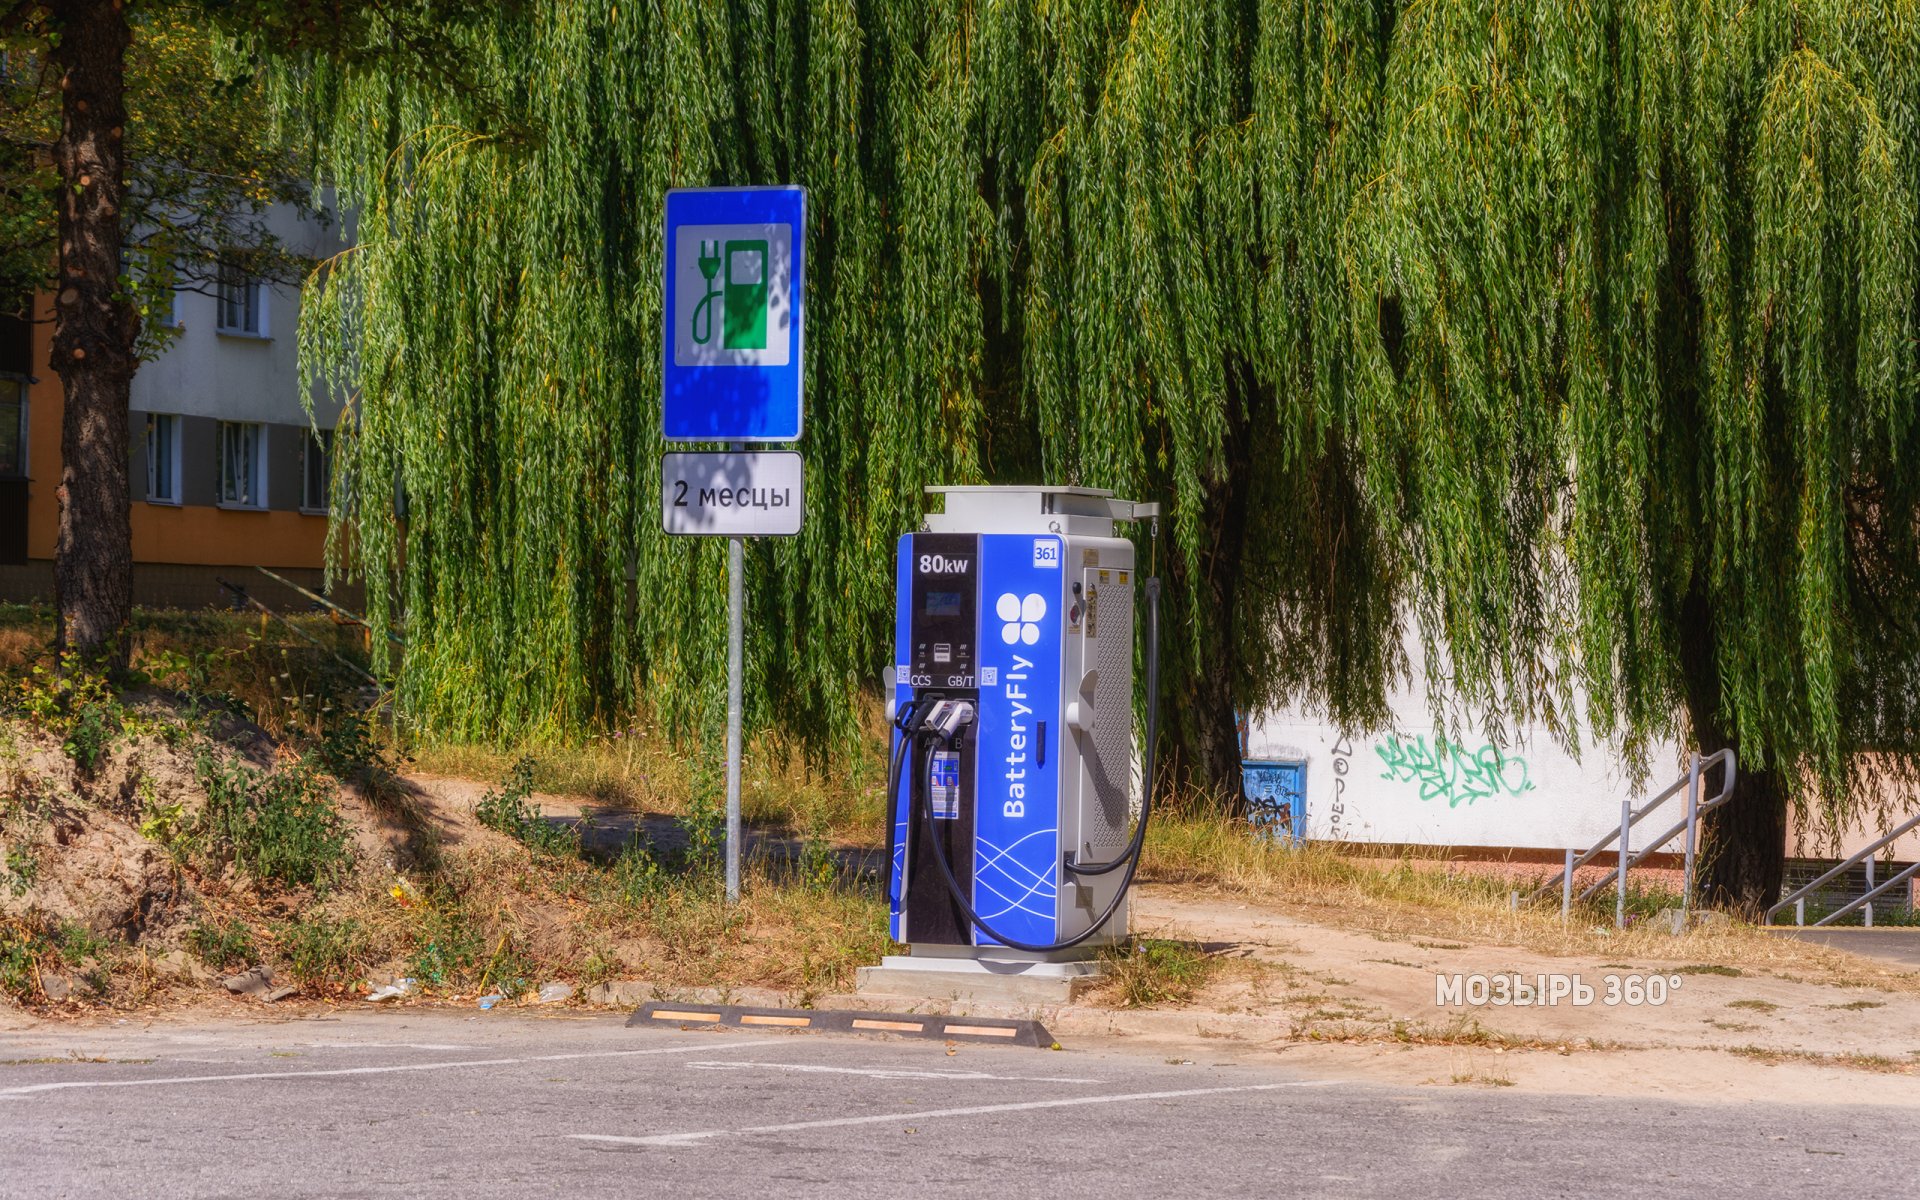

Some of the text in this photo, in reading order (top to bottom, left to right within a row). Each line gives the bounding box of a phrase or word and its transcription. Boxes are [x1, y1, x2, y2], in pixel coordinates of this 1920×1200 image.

[674, 480, 790, 511] 2 месцы
[1035, 547, 1057, 560] 361
[910, 674, 932, 687] CCS
[947, 675, 975, 688] GB/T
[1003, 654, 1034, 818] BatteryFly
